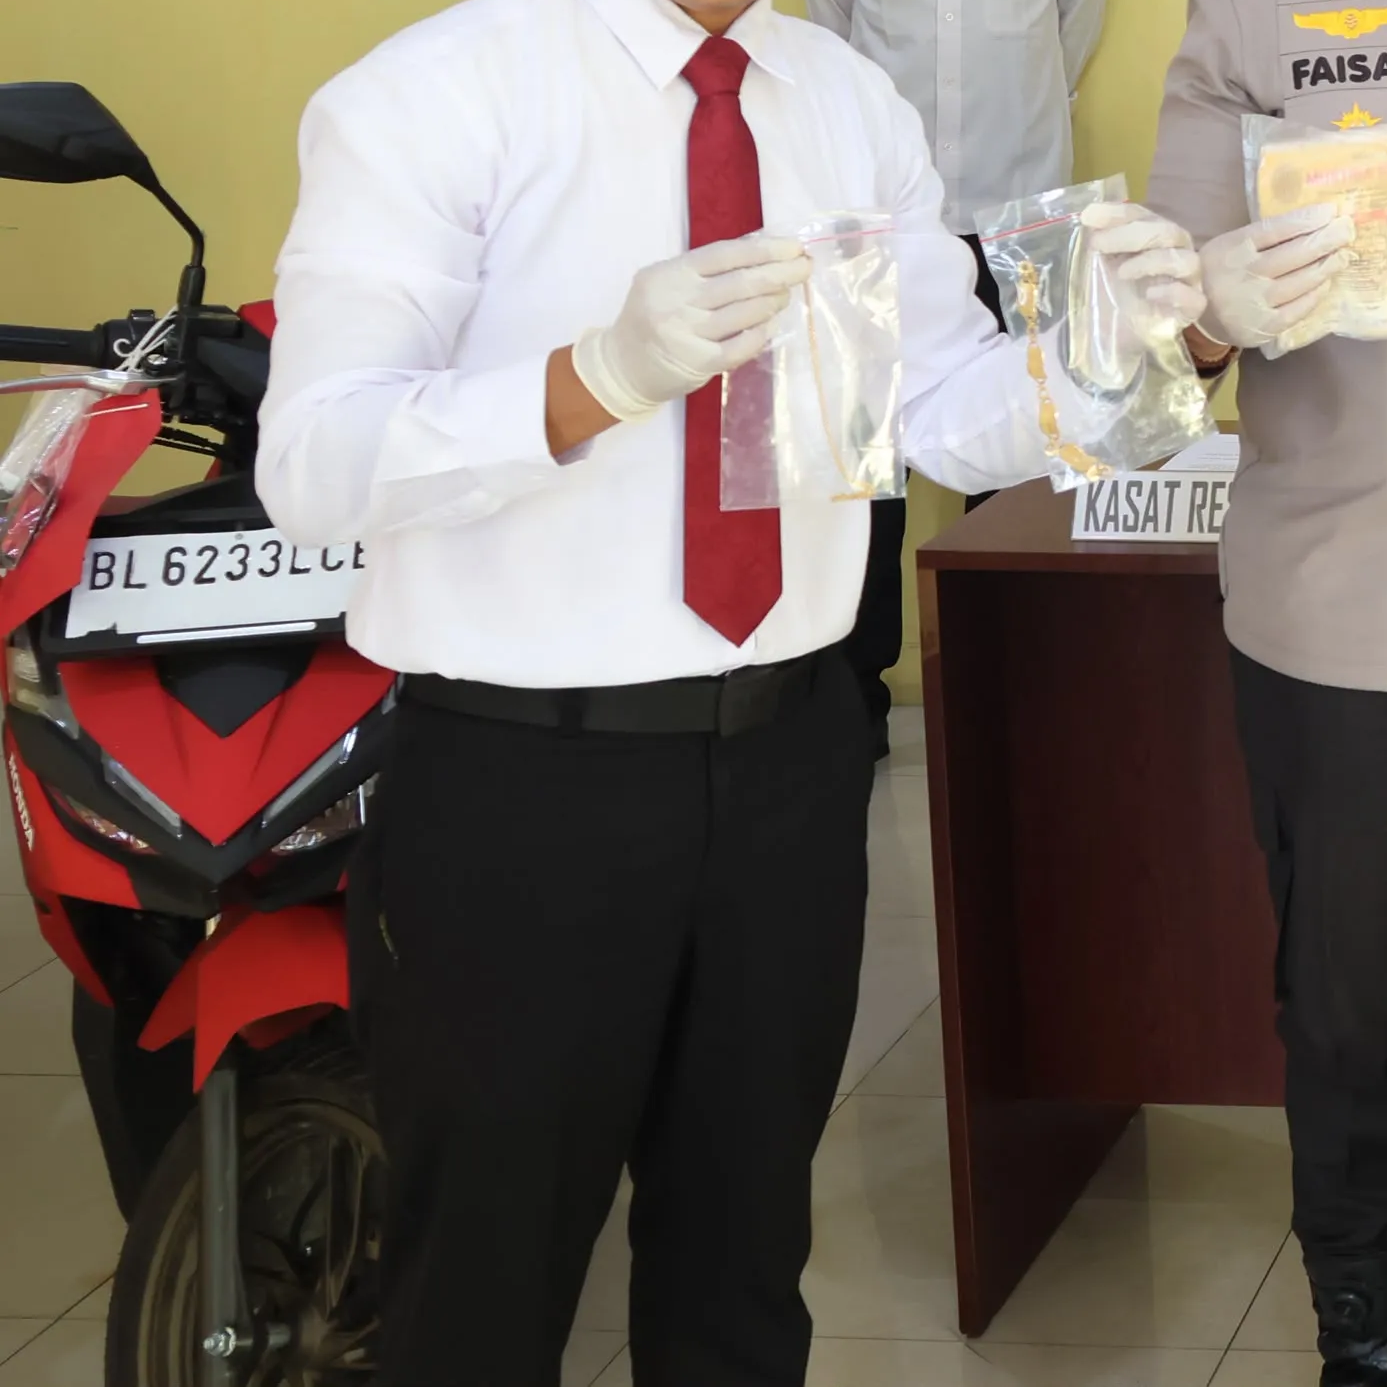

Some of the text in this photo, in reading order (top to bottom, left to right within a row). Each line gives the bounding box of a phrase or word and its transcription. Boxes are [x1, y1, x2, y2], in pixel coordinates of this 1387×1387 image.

[1083, 479, 1182, 533] KASAT
[88, 549, 147, 591] BL
[162, 539, 283, 587] 6233
[8, 751, 35, 852] HONDA
